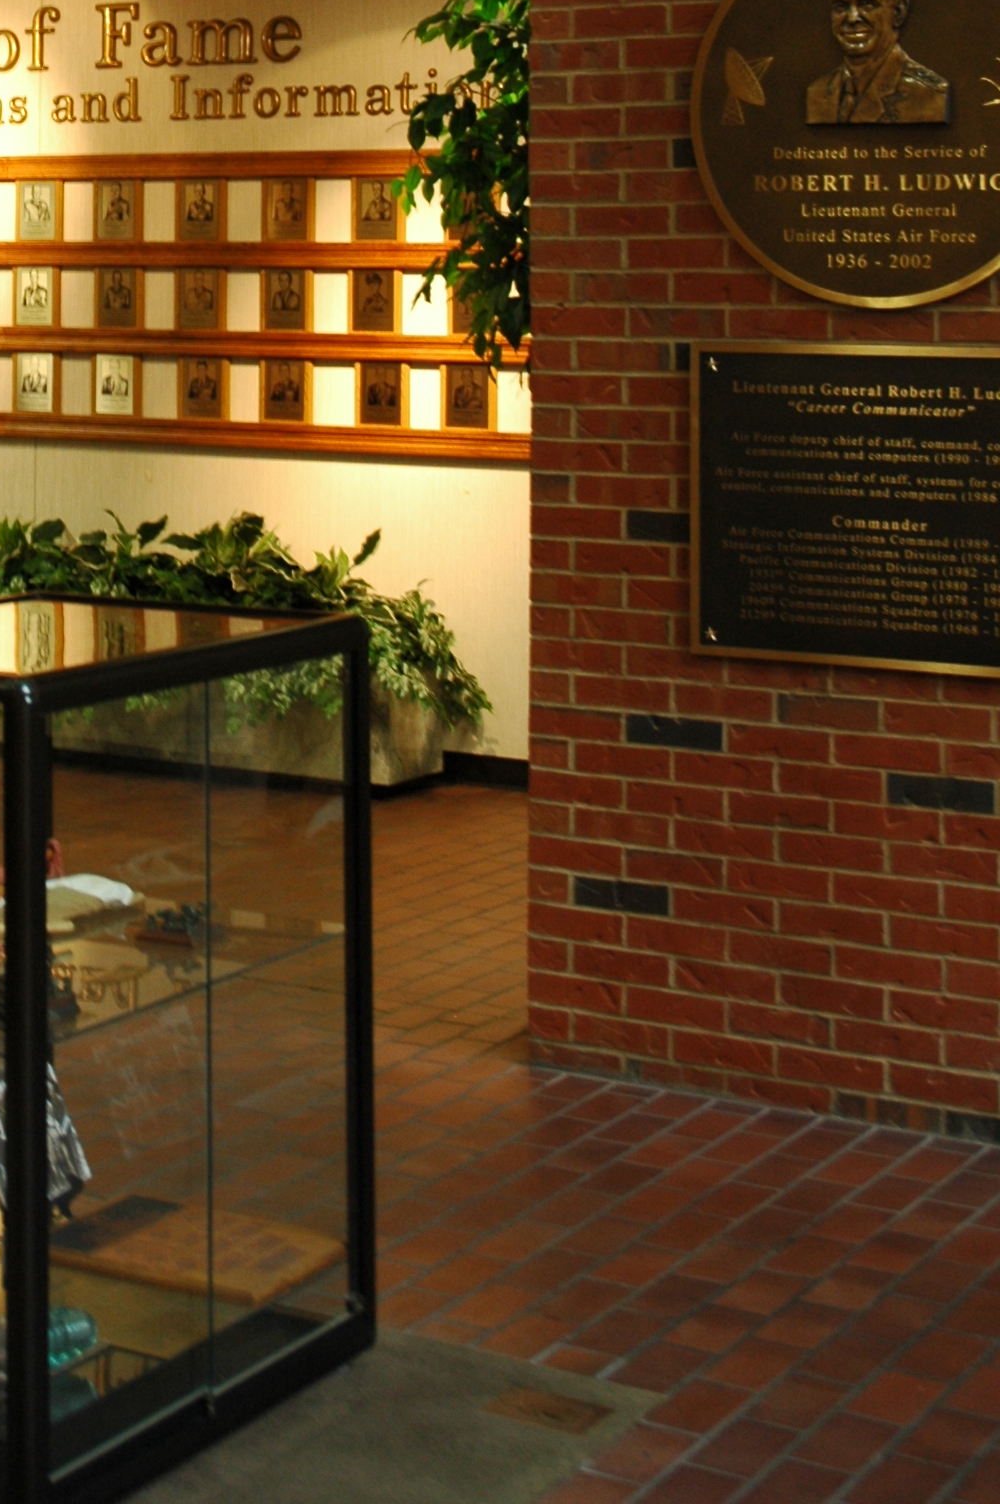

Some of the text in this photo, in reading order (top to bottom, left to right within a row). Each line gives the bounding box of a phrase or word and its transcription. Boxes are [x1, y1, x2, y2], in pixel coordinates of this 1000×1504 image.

[94, 1, 303, 68] Fame
[50, 76, 142, 125] and
[773, 144, 989, 160] Dedicated to the Service of
[754, 174, 855, 192] ROBERT
[864, 174, 889, 192] H.
[801, 202, 958, 218] Lieutenant General
[783, 228, 977, 244] United States Air Force
[827, 253, 868, 269] 1936
[889, 253, 932, 269] 2002
[732, 380, 815, 395] Lieutenant
[820, 382, 882, 398] General
[888, 384, 943, 399] Robert
[949, 386, 967, 400] H.
[789, 434, 829, 447] deputy
[833, 435, 864, 447] chief
[867, 437, 882, 447] of
[745, 447, 840, 460] communications
[843, 449, 865, 461] and
[868, 452, 931, 464] computers
[773, 469, 824, 481] assistant
[828, 470, 860, 482] chief
[862, 472, 877, 483] of
[915, 476, 965, 488] systems
[968, 477, 988, 488] for
[770, 484, 866, 497] communications
[869, 488, 891, 498] and
[894, 490, 958, 502] computers
[832, 514, 928, 532] Commander
[787, 528, 886, 545] Communications
[889, 534, 951, 548] Command
[777, 542, 848, 556] Information
[851, 546, 901, 560] Systems
[904, 549, 958, 562] Division
[783, 556, 883, 573] Communications
[885, 562, 939, 576] Division
[788, 570, 887, 587] Communications
[890, 576, 929, 591] Group
[788, 584, 887, 601] Communications
[890, 590, 929, 605] Group
[881, 604, 939, 619] Squadron
[881, 618, 939, 633] Squadron
